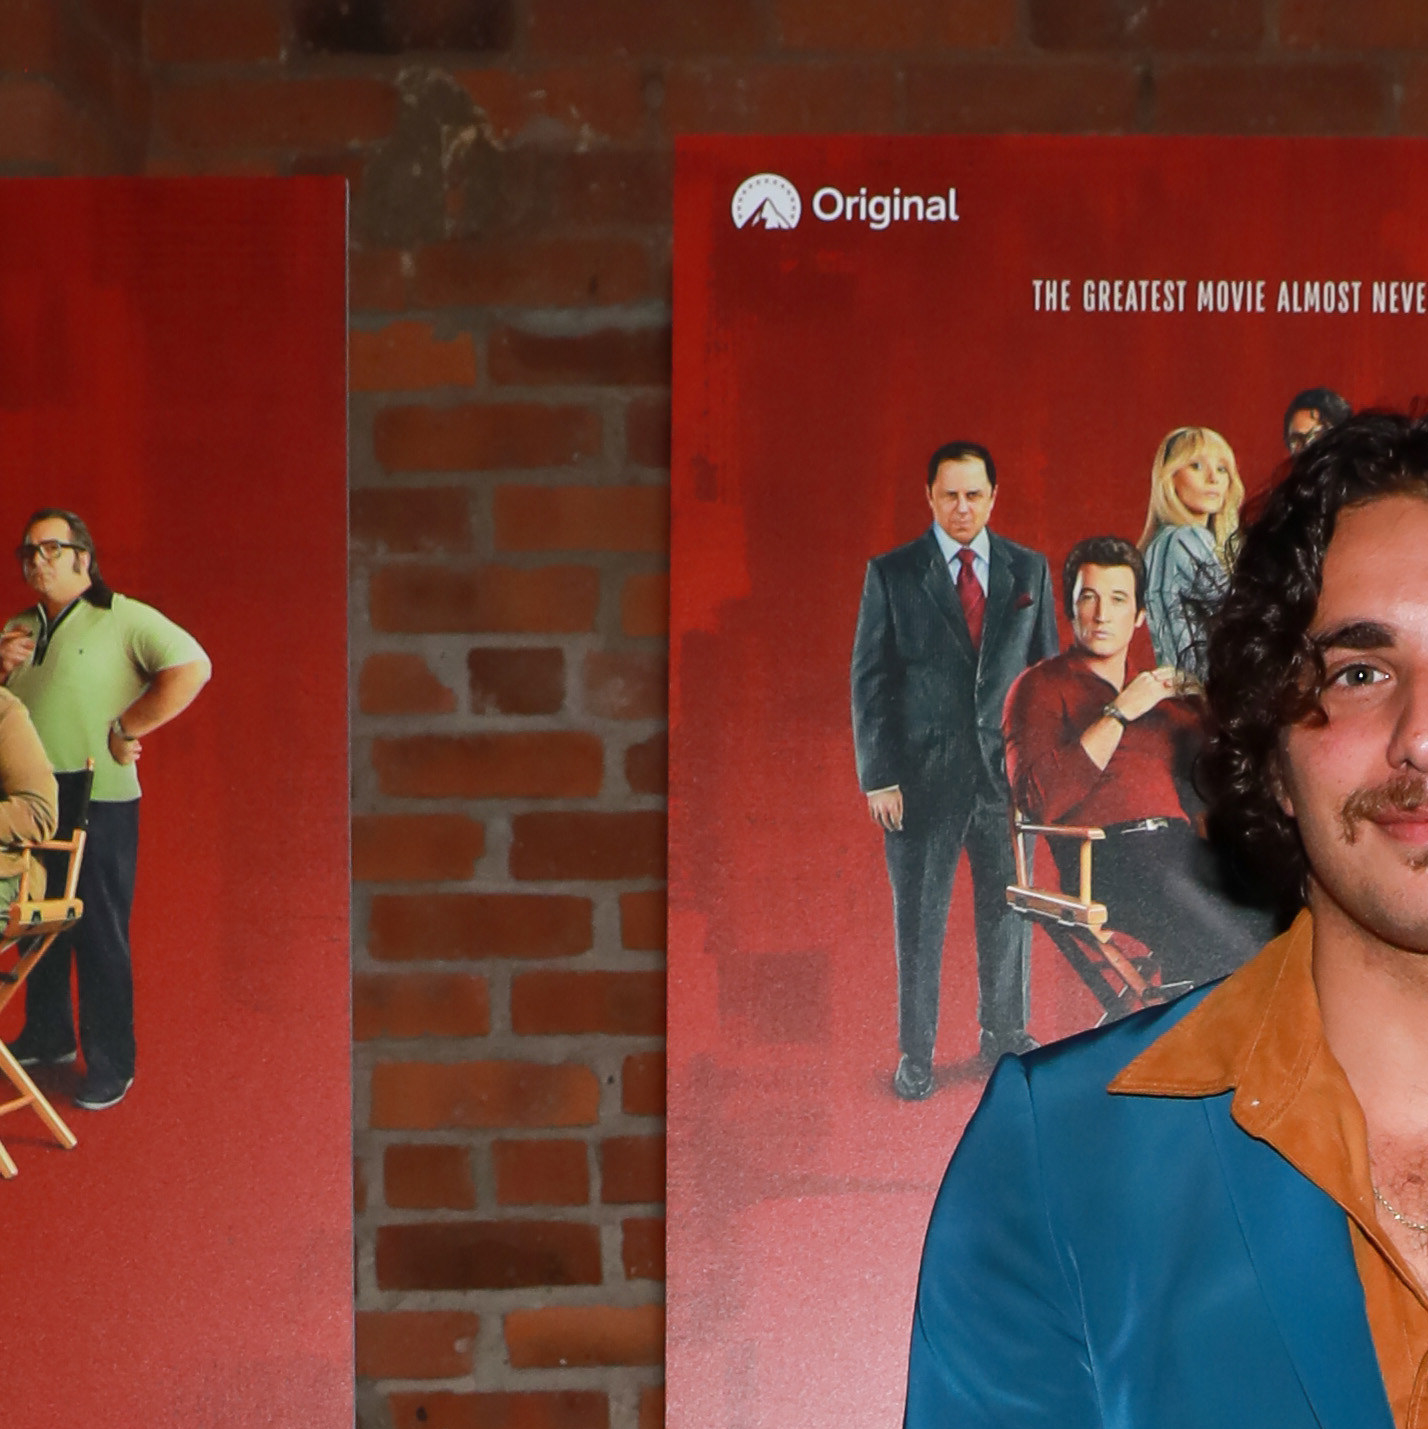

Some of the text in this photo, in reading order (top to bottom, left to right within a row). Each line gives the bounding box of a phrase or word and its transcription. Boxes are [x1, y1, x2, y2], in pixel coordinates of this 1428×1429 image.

[812, 186, 960, 230] Original
[1032, 280, 1072, 313] THE
[1084, 280, 1187, 314] GREATEST
[1198, 281, 1267, 314] MOVIE
[1277, 282, 1362, 315] ALMOST
